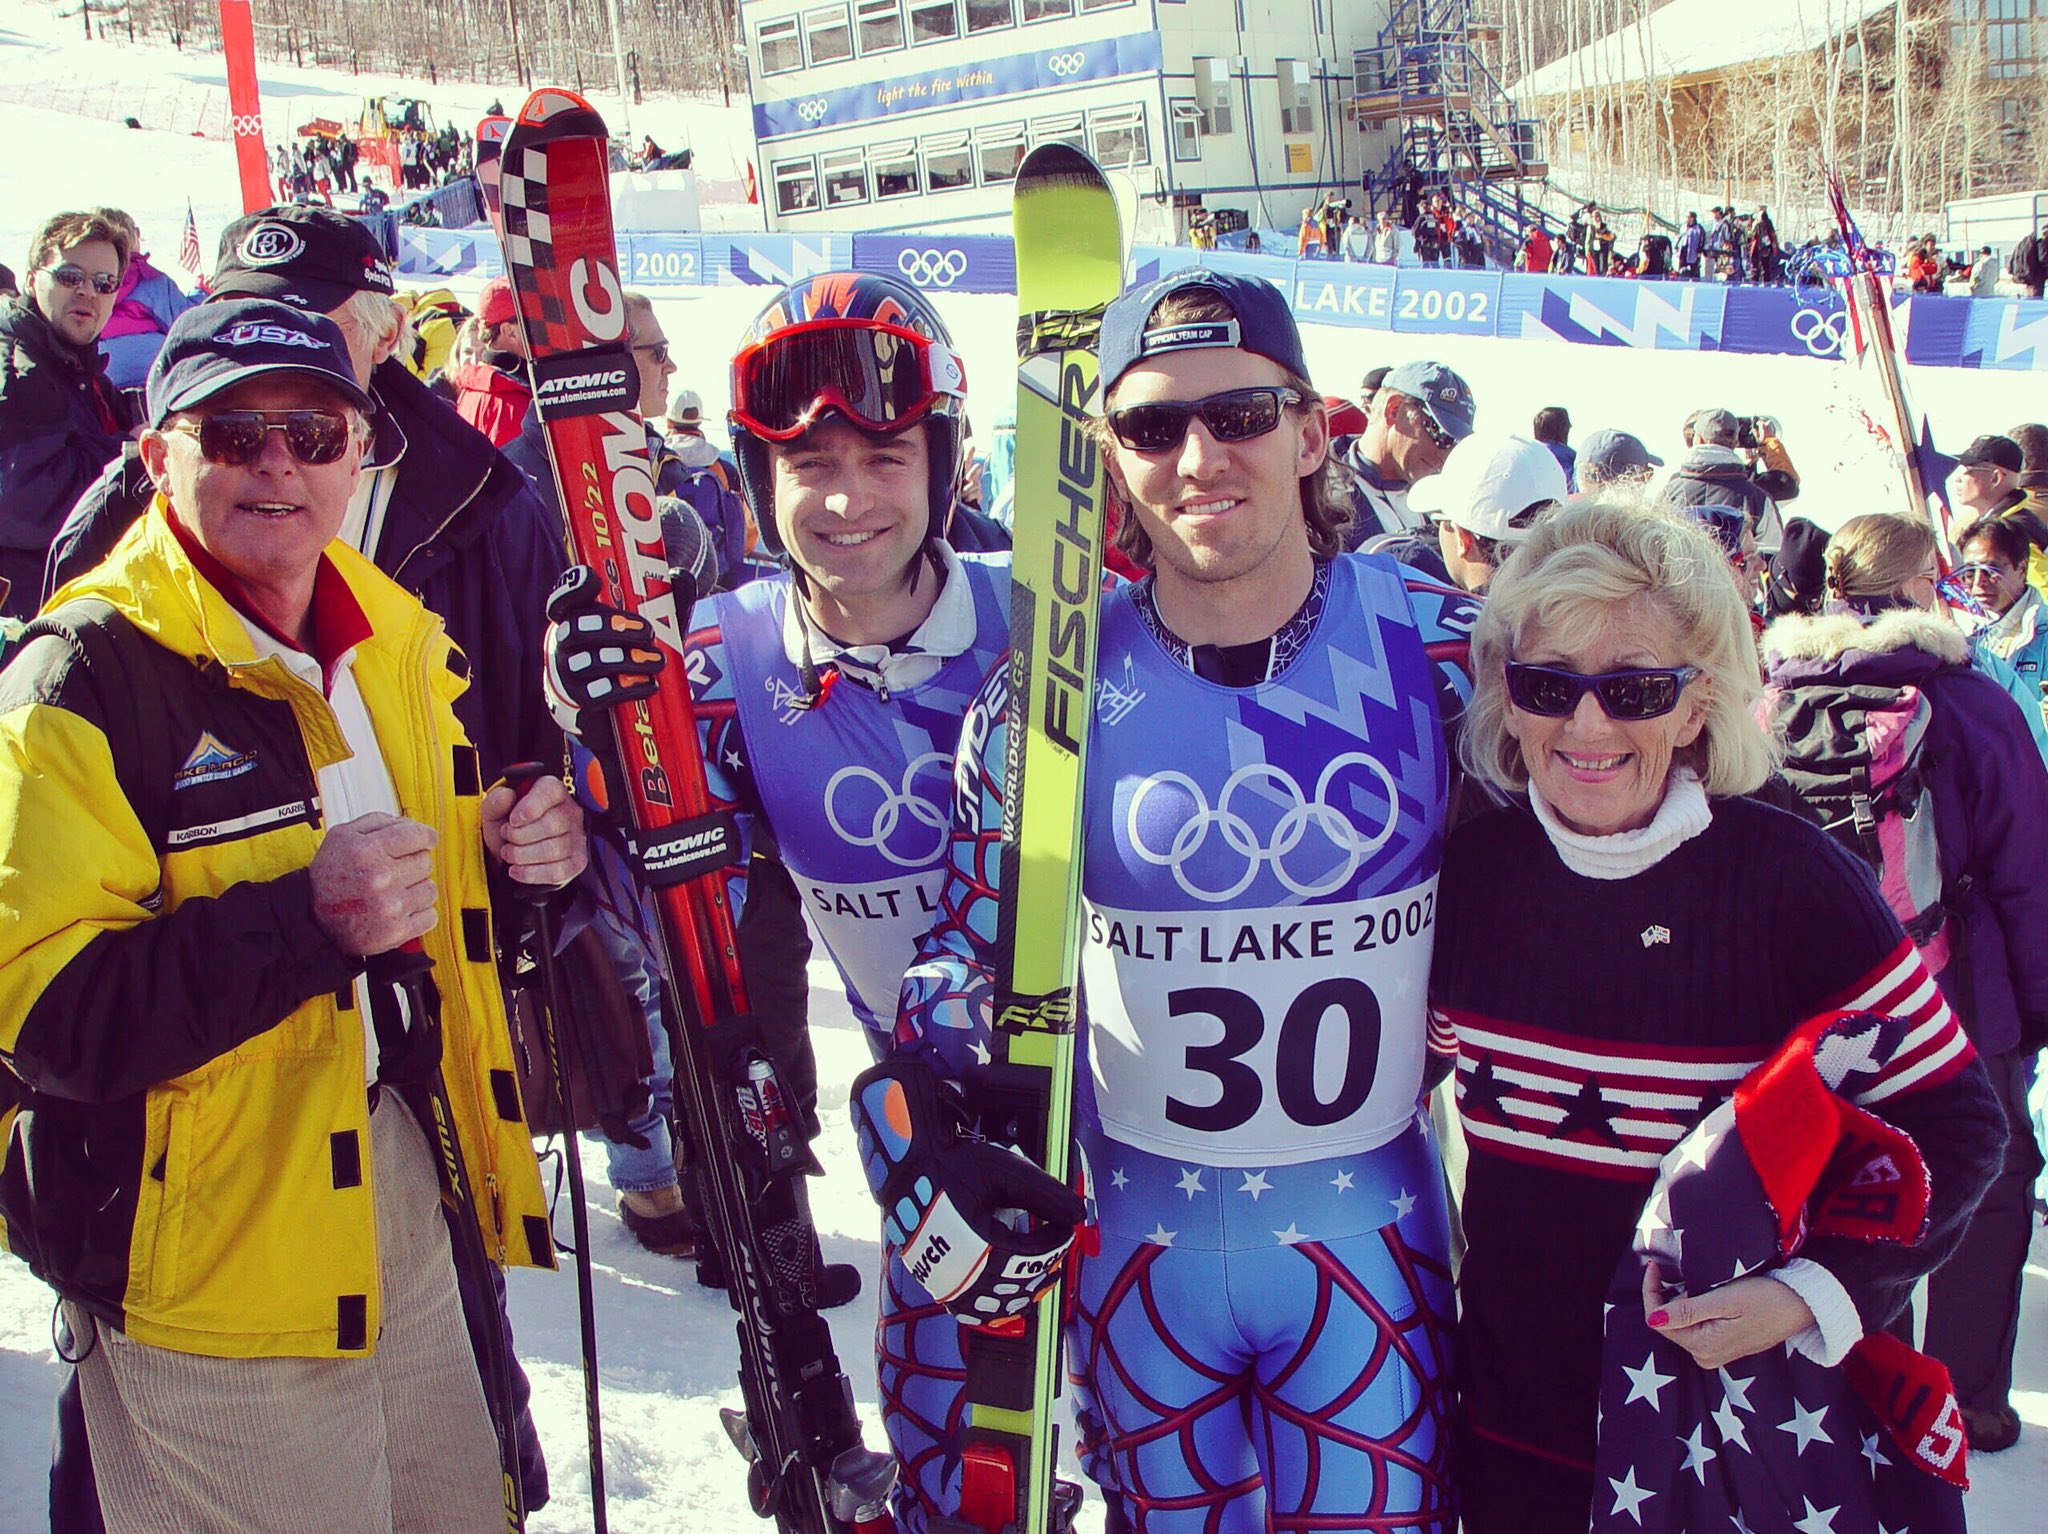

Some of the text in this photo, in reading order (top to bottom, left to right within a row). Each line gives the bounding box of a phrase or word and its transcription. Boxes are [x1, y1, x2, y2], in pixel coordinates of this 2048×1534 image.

[877, 87, 906, 107] light
[908, 82, 928, 97] the
[931, 78, 952, 97] fire
[635, 252, 696, 278] 2002
[1295, 281, 1488, 323] LAKE 2002
[233, 325, 312, 349] USA
[1178, 330, 1198, 341] TEAM
[1199, 329, 1213, 339] CAP
[537, 369, 627, 394] ATOMIC
[537, 386, 627, 407] www.atomicsnow.com
[570, 256, 684, 654] ATOMC
[1043, 362, 1101, 757] FISCHER
[1012, 648, 1025, 689] GS
[954, 660, 1010, 836] SPYDE
[278, 802, 307, 818] KARB
[176, 825, 218, 842] KARBON
[643, 827, 725, 860] ATOMIC
[643, 842, 728, 871] www.atomicsnow.com
[811, 887, 901, 919] SALT
[1091, 891, 1434, 963] SALT LAKE 2002
[1165, 976, 1382, 1133] 30
[432, 1094, 465, 1202] SWIX
[912, 1233, 952, 1284] eusch
